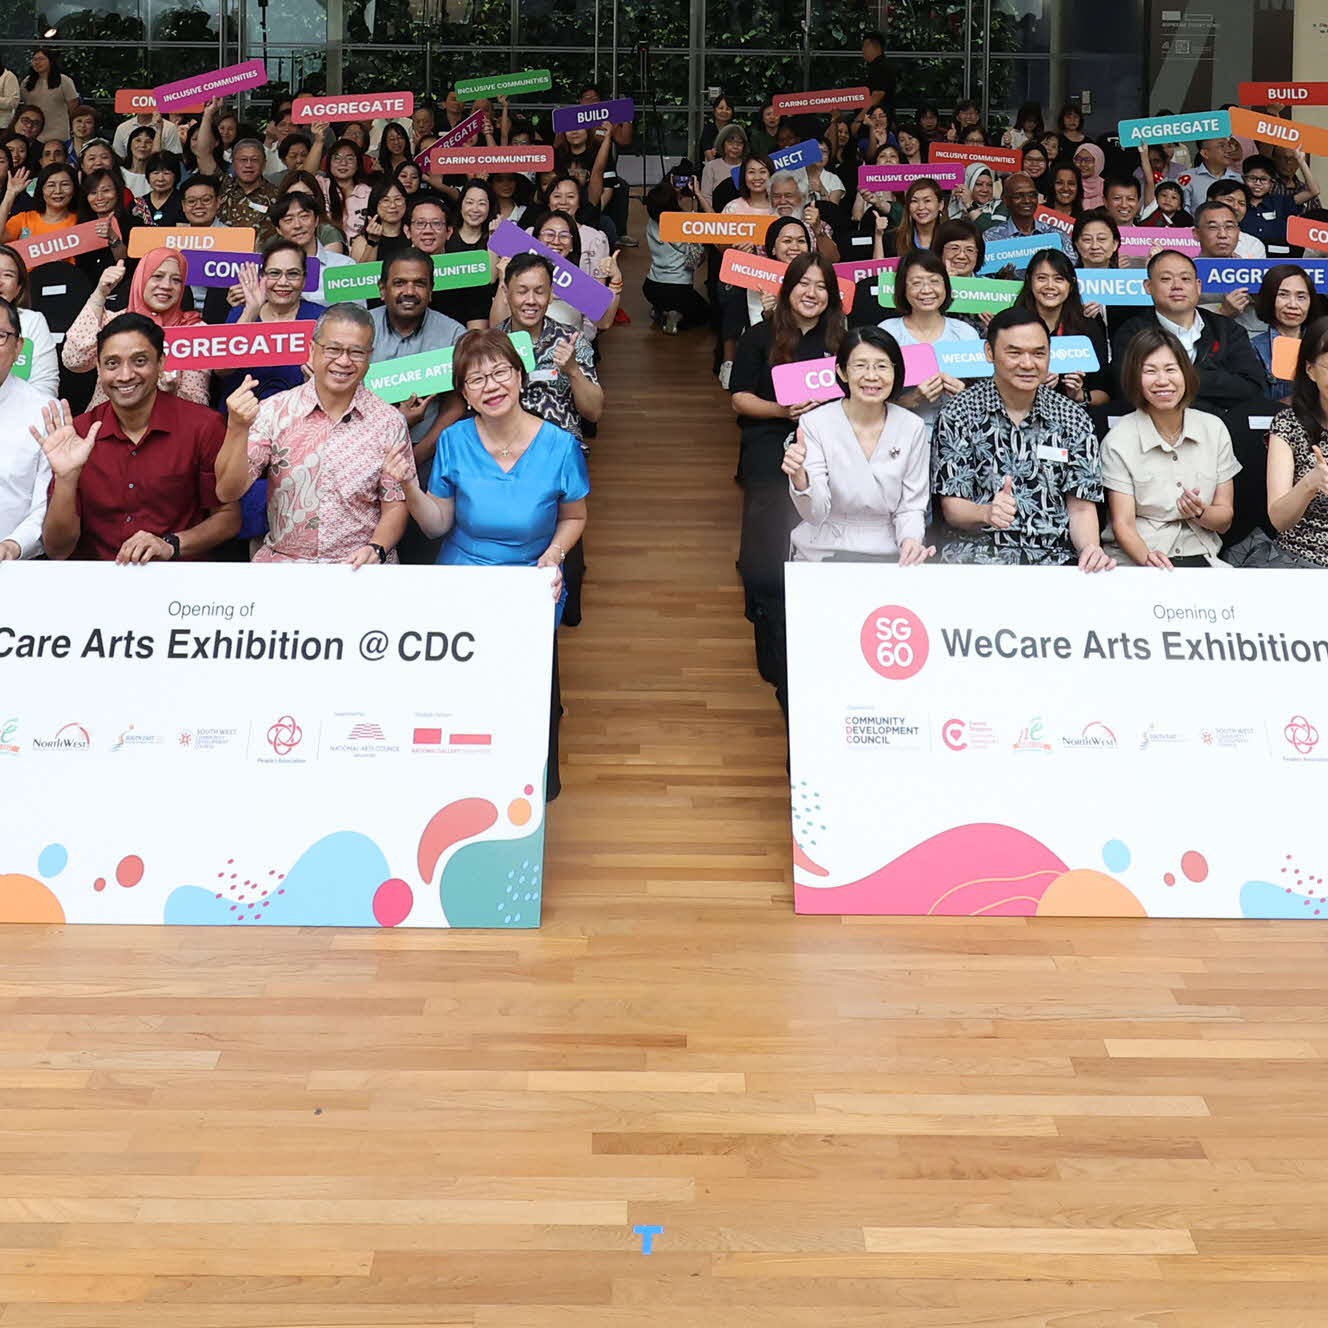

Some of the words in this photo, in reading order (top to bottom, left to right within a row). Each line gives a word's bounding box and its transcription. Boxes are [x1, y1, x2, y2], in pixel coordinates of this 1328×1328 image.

[163, 86, 203, 103] INCLUSIVE
[203, 69, 258, 91] COMMUNITIES
[457, 83, 496, 95] INCLUSIVE
[496, 76, 550, 89] COMMUNITIES
[1267, 88, 1309, 100] BUILD
[300, 98, 405, 117] AGGREGATE
[778, 99, 809, 108] CARING
[809, 94, 866, 105] COMMUNITIES
[577, 108, 609, 123] BUILD
[1130, 119, 1220, 140] AGGREGATE
[1256, 121, 1300, 142] BUILD
[423, 119, 479, 167] AREGATE
[438, 156, 476, 165] CARING
[477, 154, 547, 164] COMMUNITIES
[773, 149, 803, 170] NECT
[935, 151, 968, 160] INCLUSIVE
[968, 154, 1016, 164] COMMUNITIES
[865, 174, 903, 183] INCLUSIVE
[681, 220, 757, 237] CONNECT
[27, 233, 81, 260] BUILD
[165, 235, 215, 250] BUILD
[1154, 238, 1201, 248] COMMUN
[327, 274, 383, 289] INCLUSI
[730, 263, 777, 283] INCLUSIVE
[1207, 268, 1325, 284] AGGRTE
[950, 289, 1019, 303] COMMUNIT
[370, 370, 422, 391] WECARE
[167, 600, 234, 621] Opening
[240, 600, 255, 618] of
[1153, 604, 1217, 622] Opening
[1221, 604, 1236, 620] of
[875, 617, 913, 641] SG
[80, 628, 155, 659] Arts
[167, 628, 344, 661] Exhibition
[358, 632, 390, 662] @
[397, 631, 476, 663] CDC
[940, 627, 1072, 660] WeCare
[1083, 629, 1152, 661] Arts
[876, 642, 914, 668] 60
[845, 716, 906, 725] COMMUNITY
[845, 726, 919, 735] DEVELOPMENT
[846, 735, 891, 744] COUNCIL
